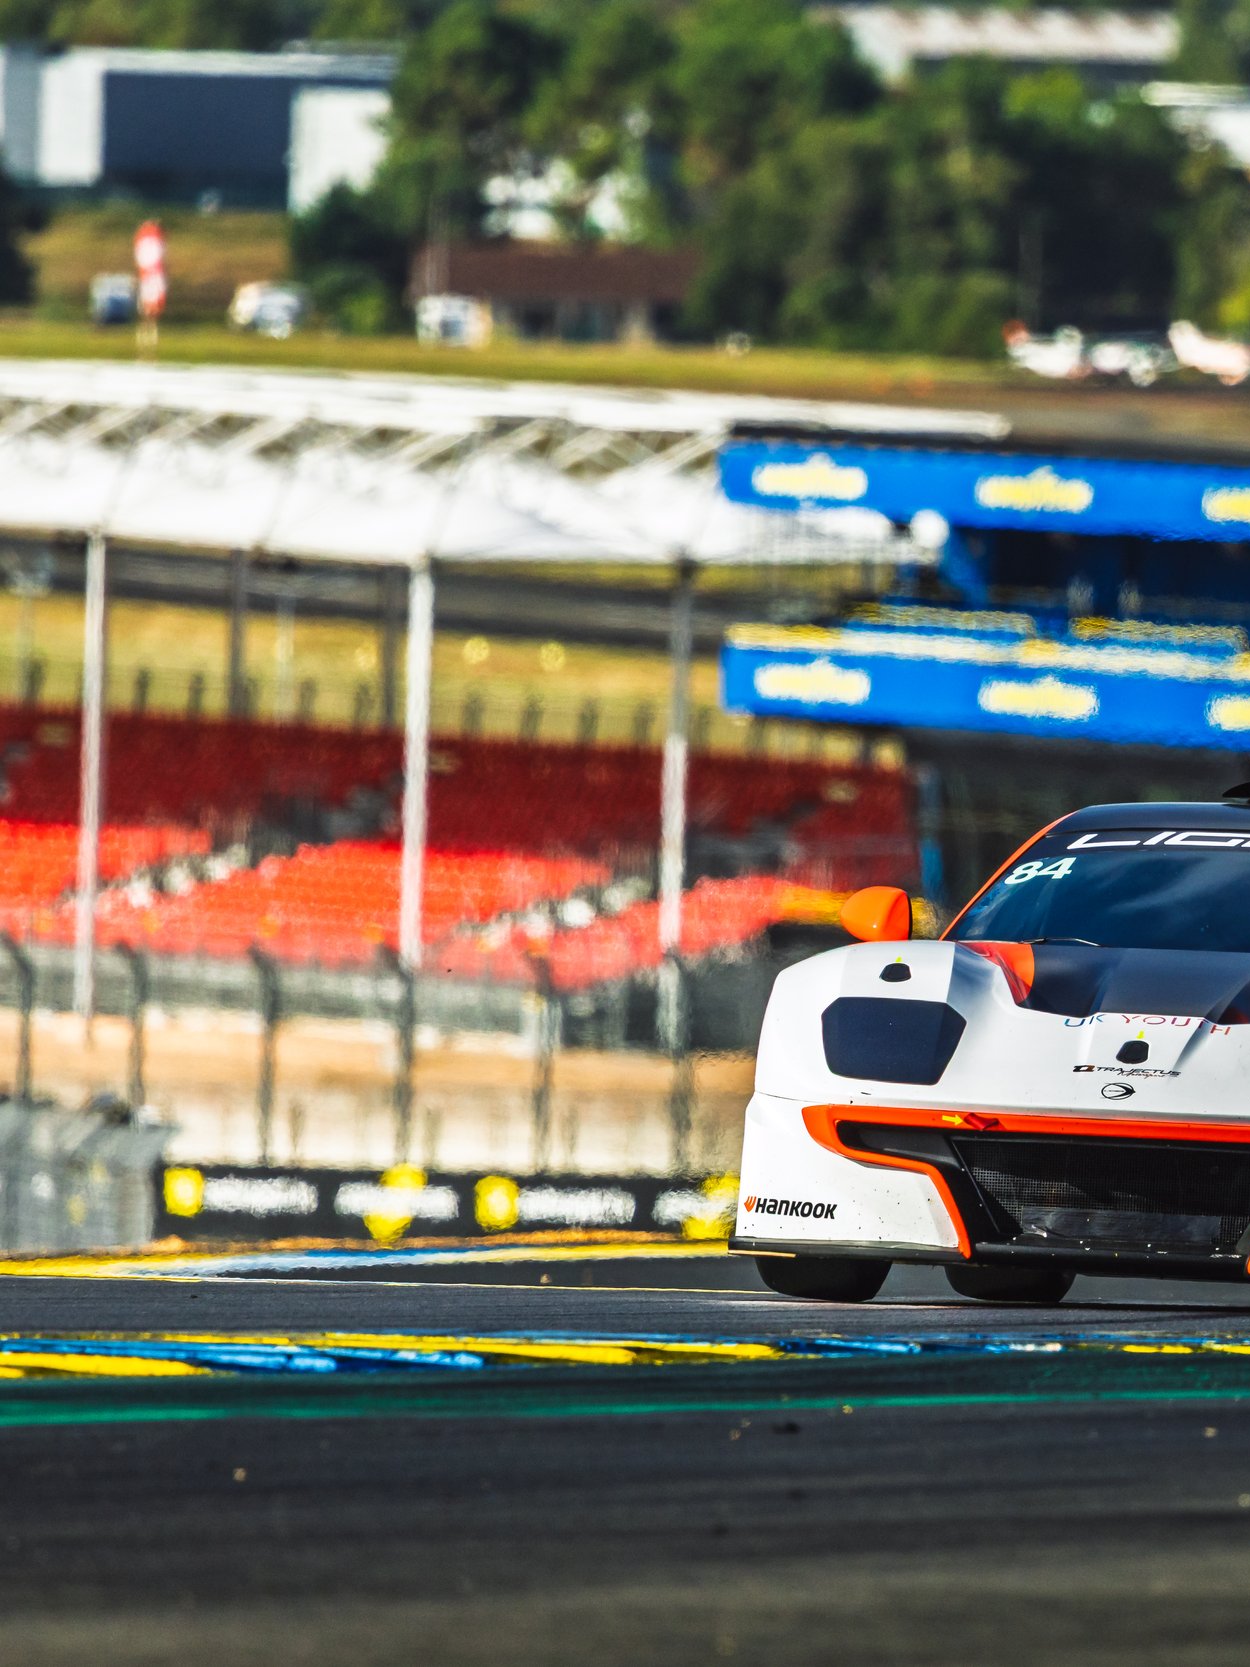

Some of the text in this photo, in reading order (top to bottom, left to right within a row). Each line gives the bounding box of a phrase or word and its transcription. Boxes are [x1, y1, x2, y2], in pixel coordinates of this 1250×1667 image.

[1004, 857, 1077, 885] 84
[1064, 1013, 1232, 1036] UK YOUTH
[1097, 1065, 1182, 1078] TRAJECTUS
